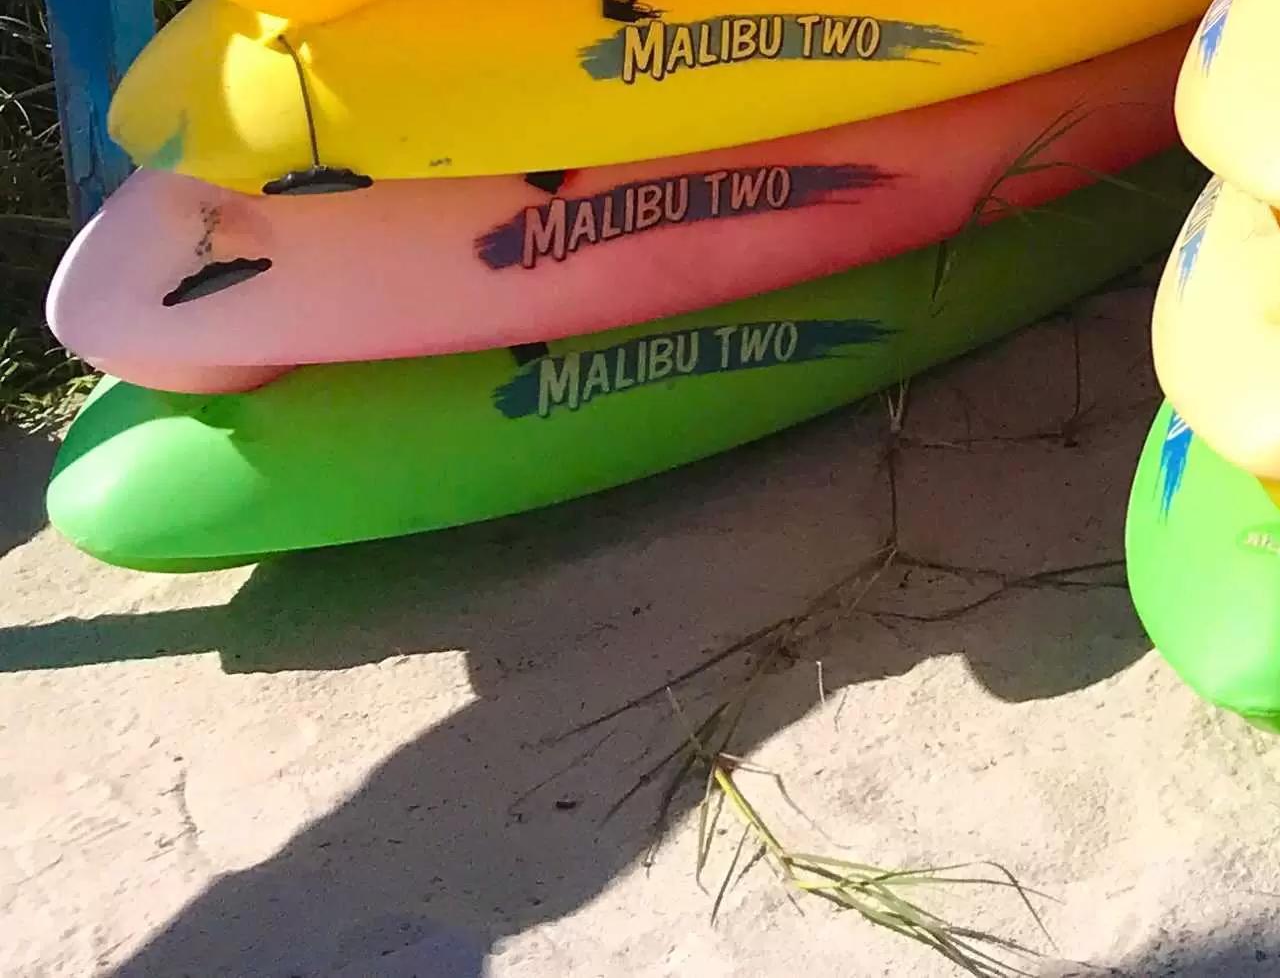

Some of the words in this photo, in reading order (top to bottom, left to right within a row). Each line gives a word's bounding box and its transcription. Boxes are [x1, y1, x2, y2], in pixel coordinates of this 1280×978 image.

[623, 14, 782, 84] MALIBU
[798, 14, 881, 59] TWO
[522, 177, 689, 269] MALIBU
[704, 166, 791, 216] TWO
[537, 329, 700, 417] MALIBU
[714, 322, 799, 370] TWO
